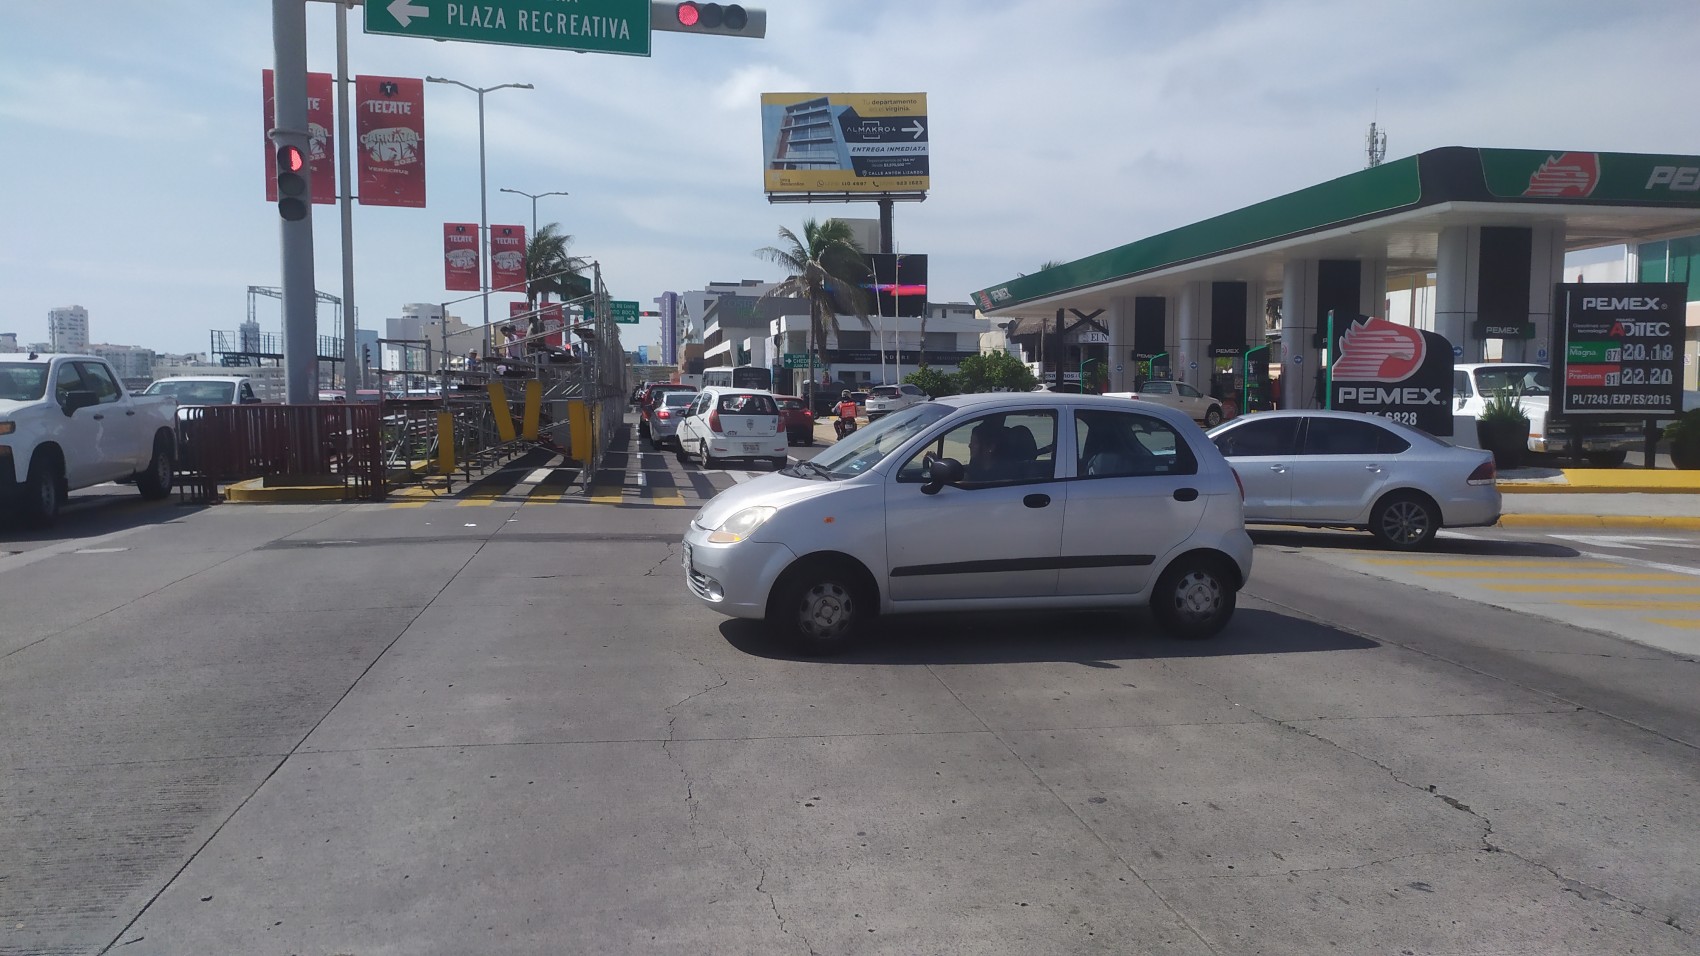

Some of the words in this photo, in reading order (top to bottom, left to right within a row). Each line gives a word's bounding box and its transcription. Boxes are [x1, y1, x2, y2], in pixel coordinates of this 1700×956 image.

[446, 3, 507, 30] PLAZA
[518, 9, 631, 40] RECREATIVA
[367, 99, 412, 115] TECATE
[360, 129, 423, 144] CARNAVAL
[393, 156, 418, 167] 2022
[367, 165, 409, 175] VERACRUZ
[1645, 165, 1700, 191] PE
[1582, 297, 1660, 311] PEMEX
[1485, 326, 1520, 334] PEMEX
[1569, 349, 1597, 357] Magna
[1606, 350, 1618, 361] 87
[1622, 344, 1674, 361] 20.18
[1606, 374, 1616, 385] 91
[1621, 368, 1673, 384] 22.20
[1338, 387, 1441, 405] PEMEX
[1385, 412, 1418, 426] 6828
